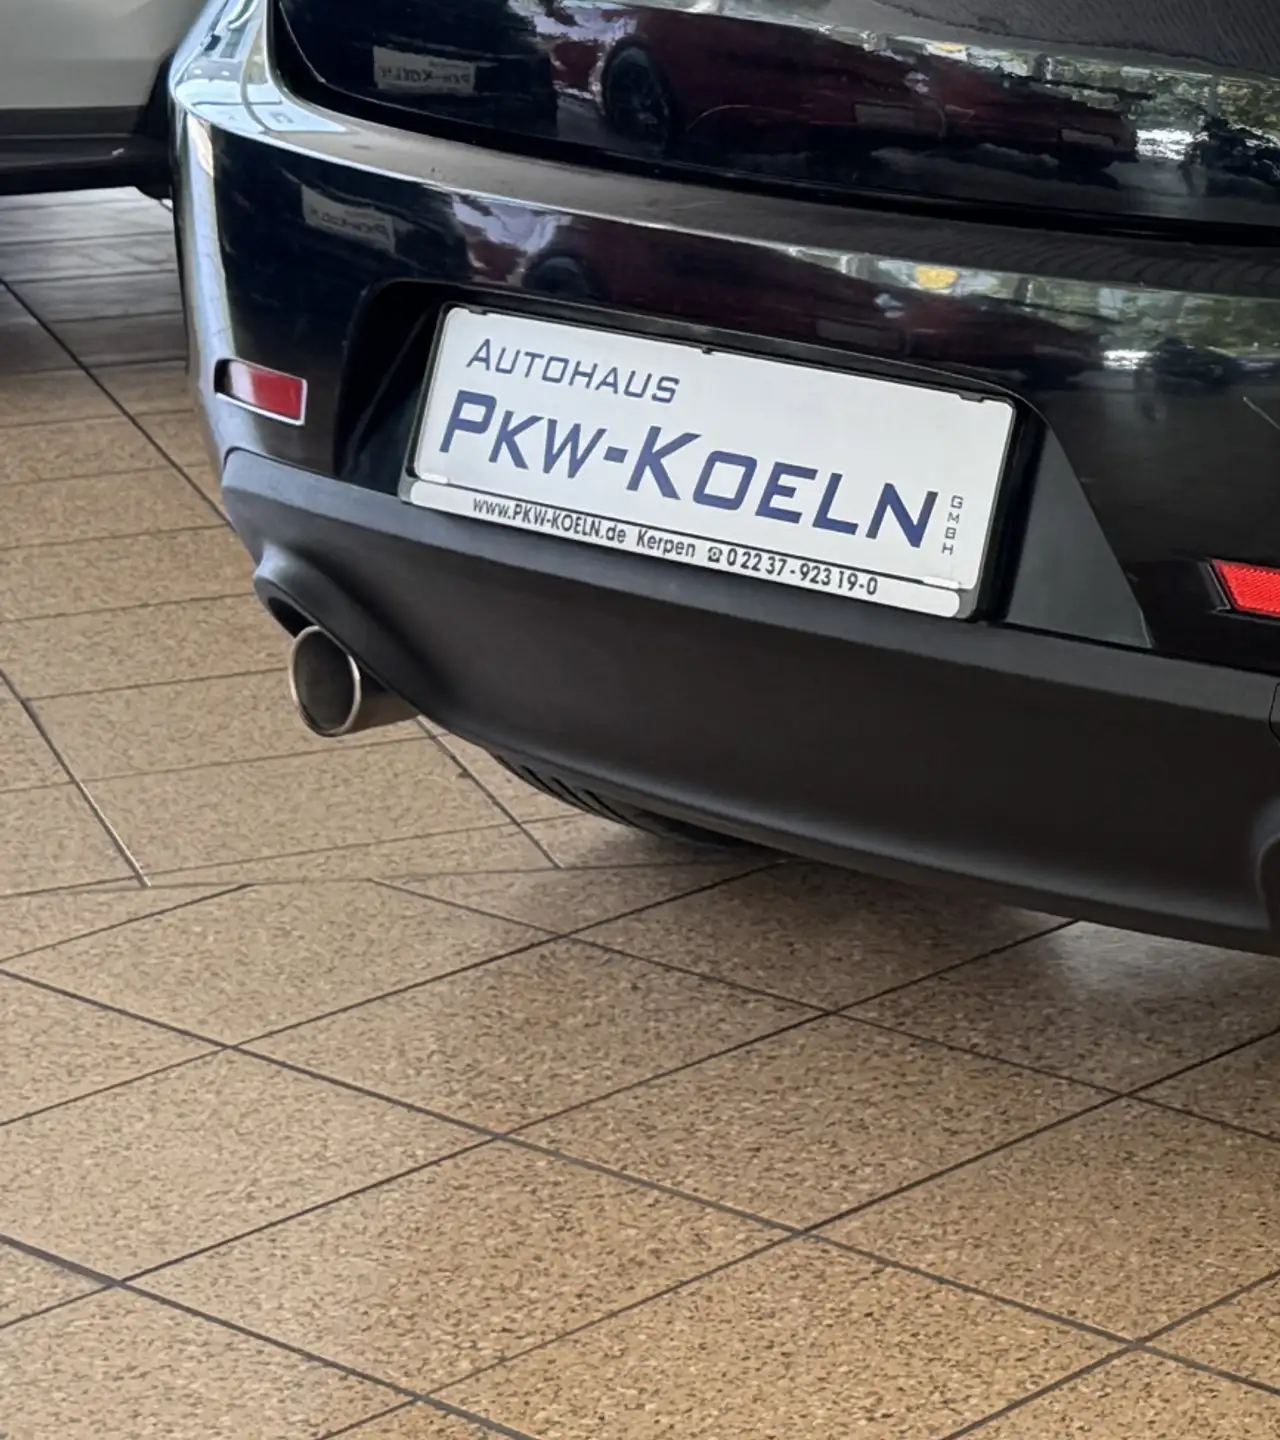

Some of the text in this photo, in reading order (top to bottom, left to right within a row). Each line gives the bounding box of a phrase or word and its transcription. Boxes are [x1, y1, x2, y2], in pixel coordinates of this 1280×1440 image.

[466, 338, 680, 403] AUTOHAUS
[439, 389, 939, 548] PKW-KOELN
[472, 497, 627, 543] www.PKW-KOELN.de
[636, 529, 696, 558] Kerpen
[941, 495, 964, 556] GMBH
